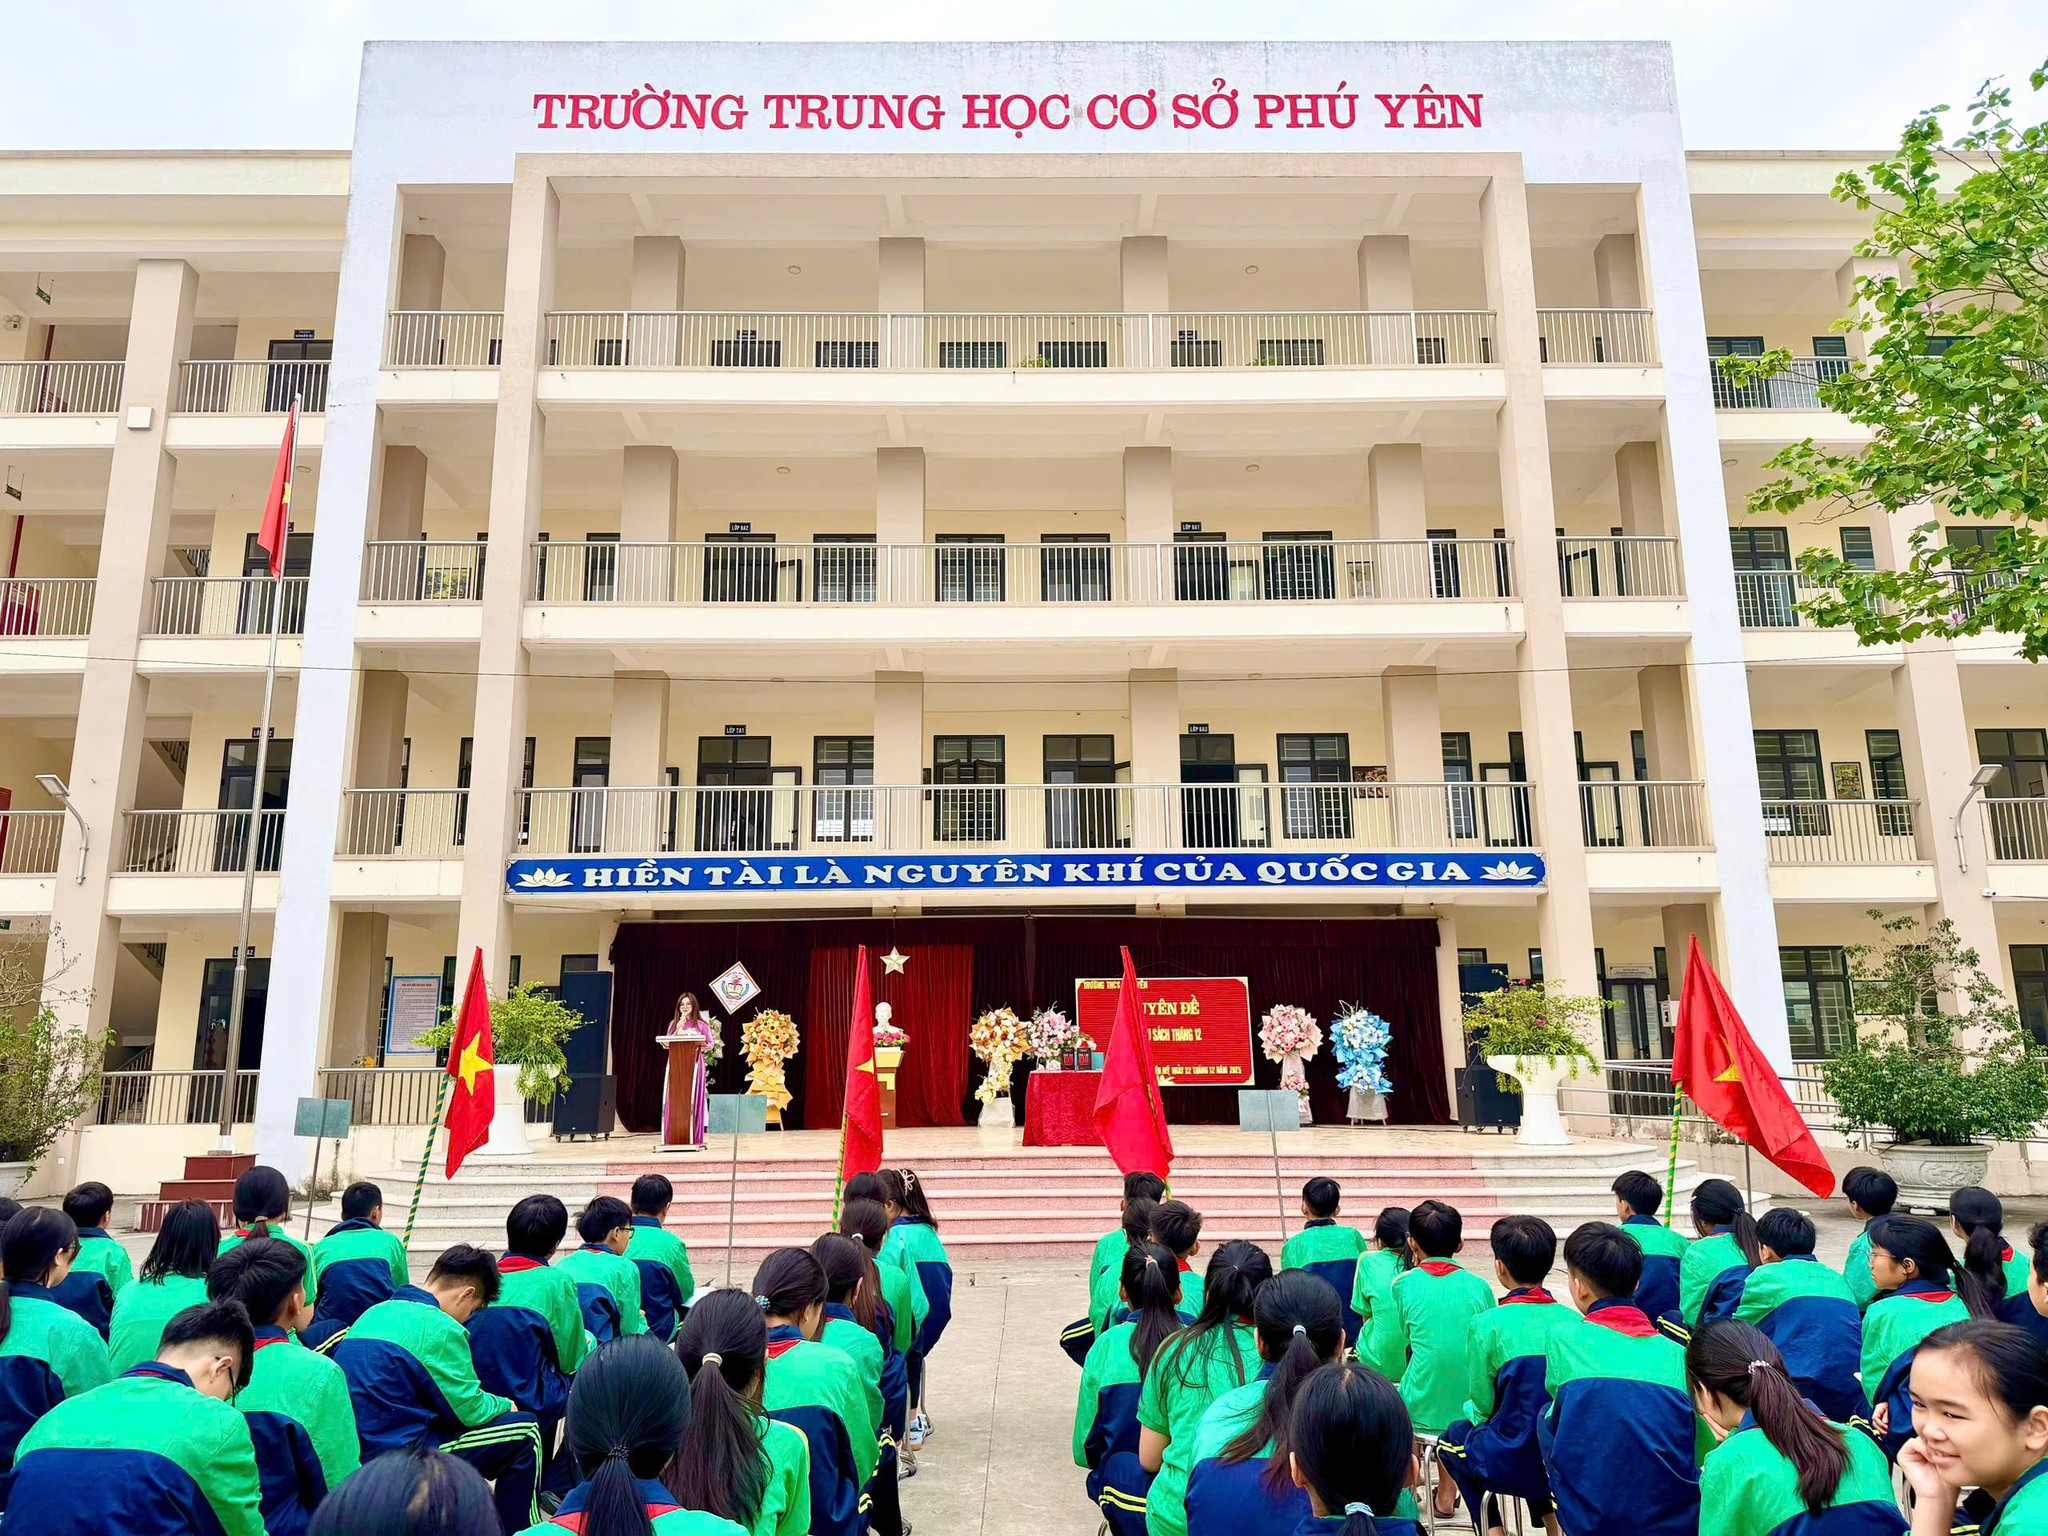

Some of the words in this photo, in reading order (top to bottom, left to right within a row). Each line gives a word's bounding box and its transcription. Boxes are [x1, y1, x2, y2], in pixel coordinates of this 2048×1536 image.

[533, 83, 749, 131] TRƯỜNG
[763, 94, 946, 131] TRUNG
[962, 93, 1071, 139] HỌC
[1086, 88, 1158, 131] CƠ
[1171, 77, 1240, 130] SỞ
[1253, 80, 1360, 130] PHÚ
[1374, 83, 1484, 129] YÊN
[583, 859, 692, 887] HIỀN
[704, 859, 783, 885] TÀI
[794, 858, 852, 884] LÀ
[864, 857, 1052, 884] NGUYÊN
[1063, 856, 1144, 882] KHÍ
[1154, 856, 1247, 881] CỦA
[1257, 853, 1378, 884] QUỐC
[1386, 861, 1471, 882] GIA
[1179, 994, 1200, 1015] ĐỀ
[1152, 1025, 1170, 1042] SÁCH
[1170, 1026, 1194, 1042] THÁNG
[1194, 1027, 1203, 1041] 12
